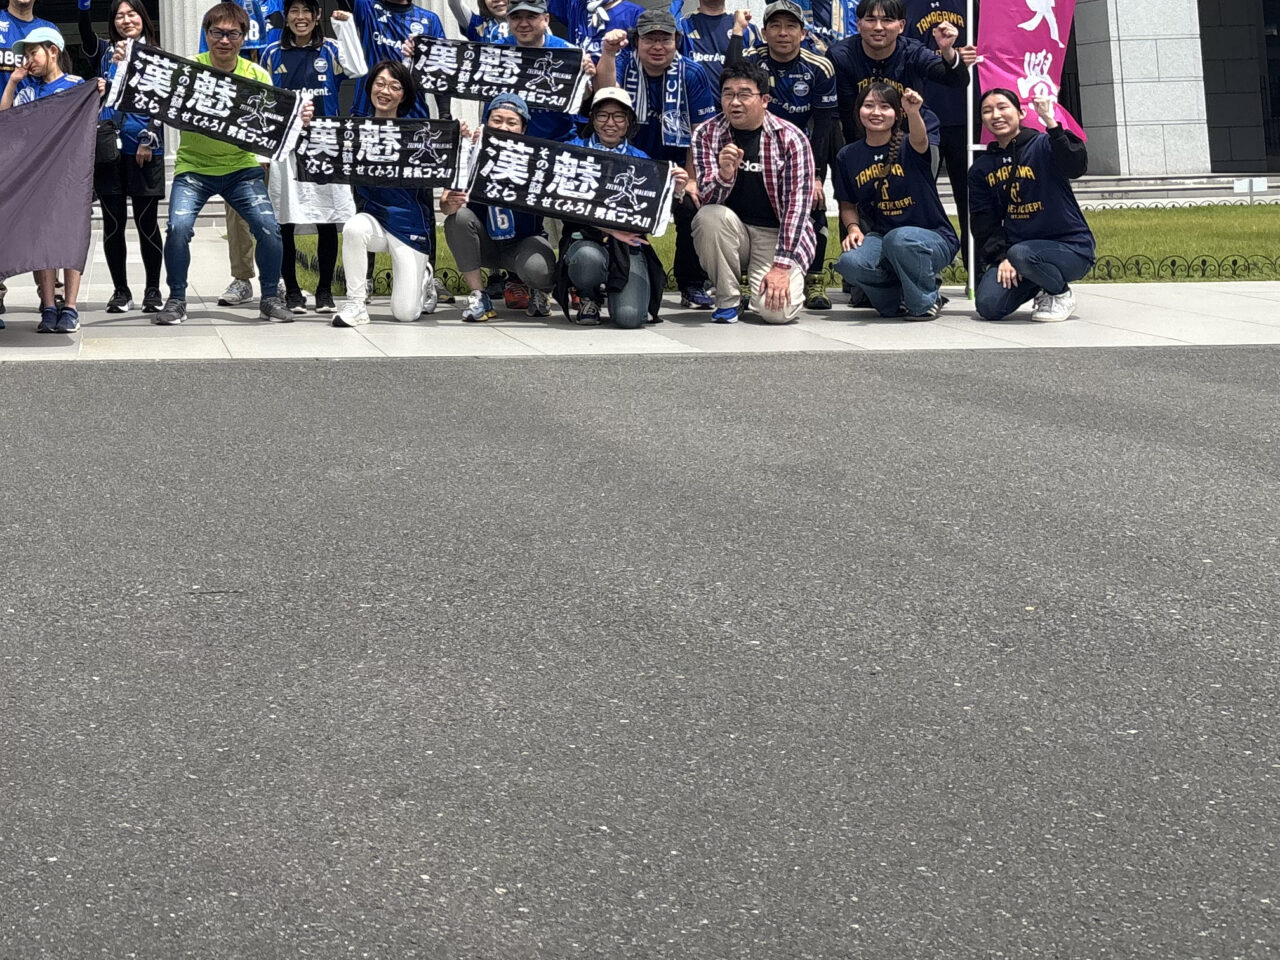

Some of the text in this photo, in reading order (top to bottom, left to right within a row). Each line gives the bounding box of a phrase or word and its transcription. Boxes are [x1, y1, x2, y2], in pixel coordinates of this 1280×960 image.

[916, 11, 964, 35] TAMAGAWA
[373, 31, 403, 49] CyberA
[689, 51, 726, 65] yberAg
[421, 73, 448, 91] なら
[133, 90, 160, 114] なら
[305, 156, 334, 175] なら
[855, 163, 904, 189] TAMAWA
[484, 179, 517, 202] なら
